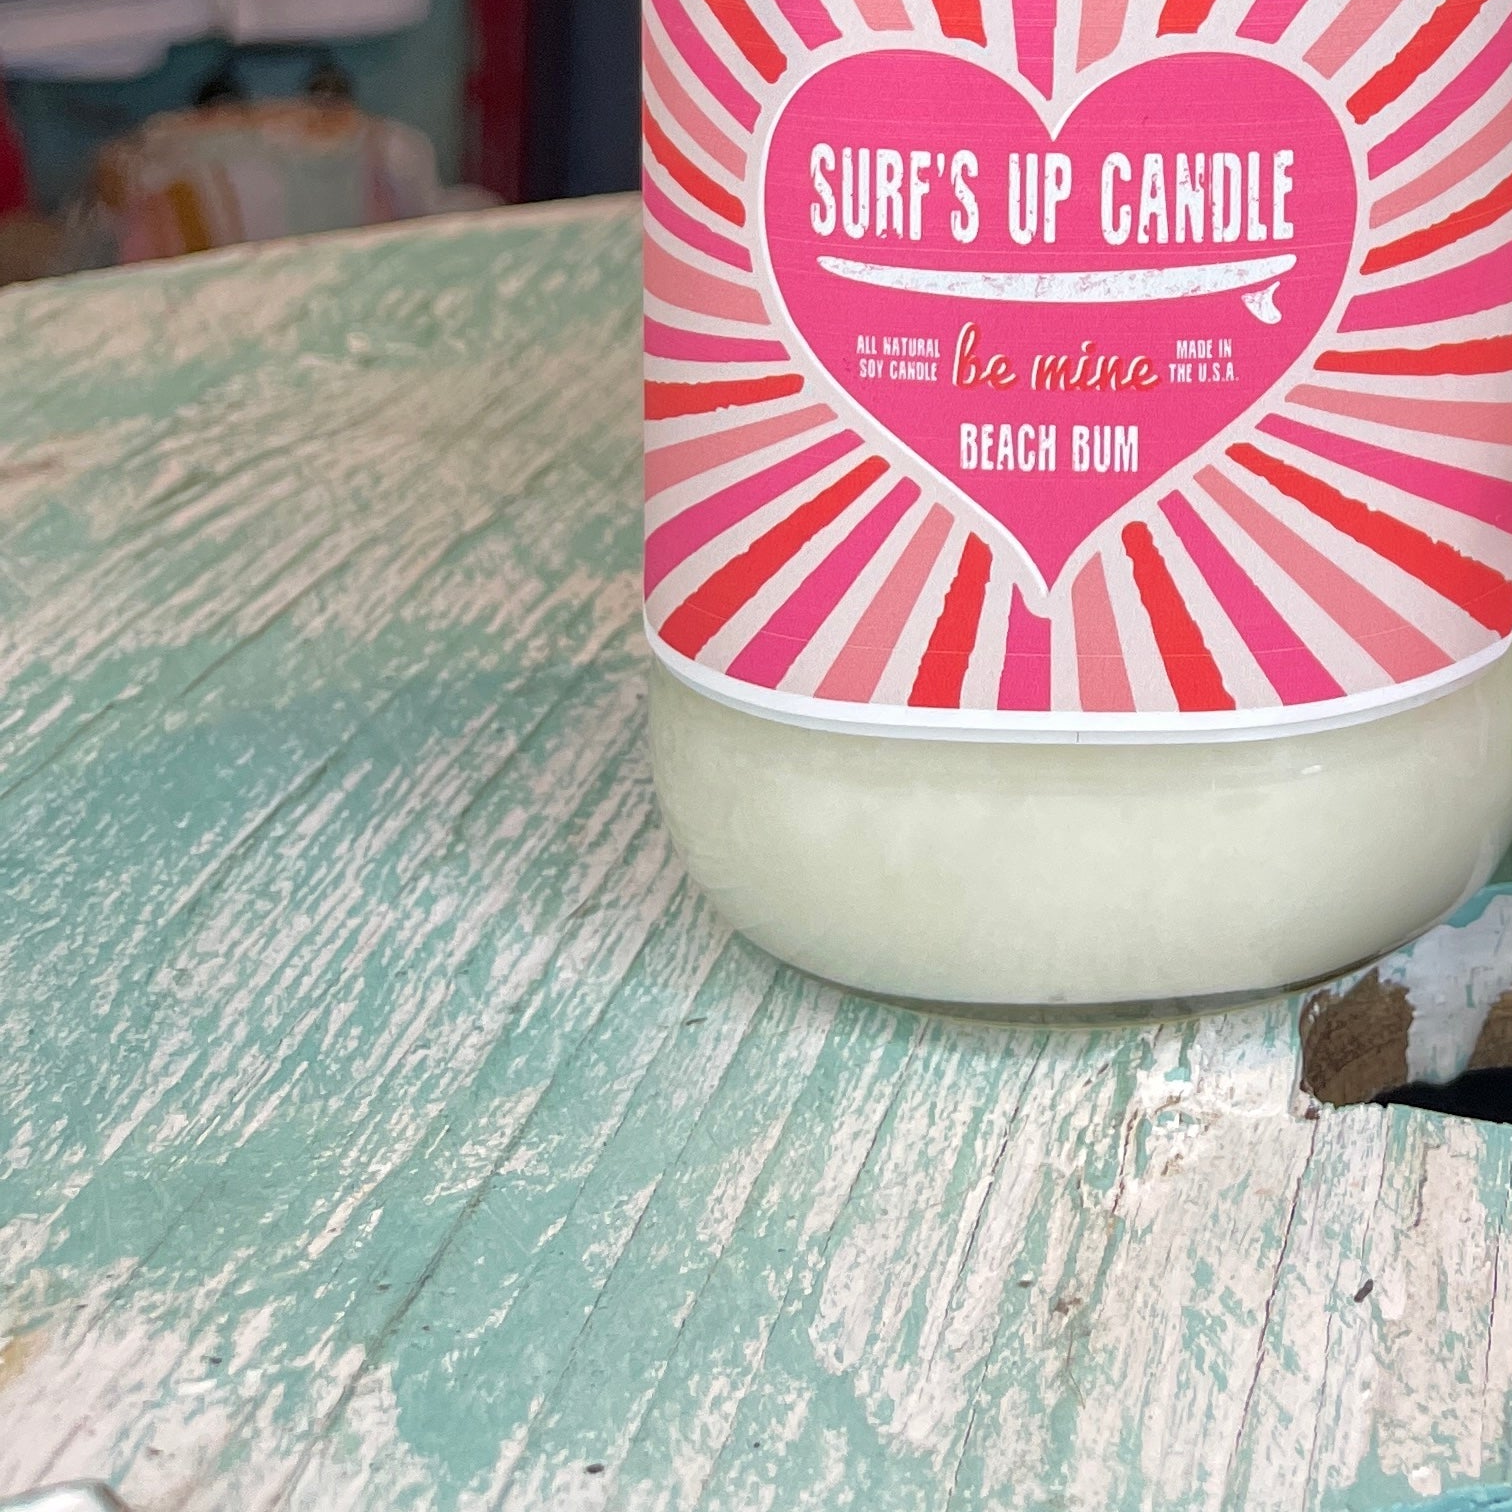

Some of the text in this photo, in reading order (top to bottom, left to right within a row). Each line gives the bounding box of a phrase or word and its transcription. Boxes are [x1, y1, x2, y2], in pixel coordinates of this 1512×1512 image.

[809, 142, 1296, 246] SURF'S UP CANDLE
[856, 334, 941, 359] ALL NATURAL
[952, 321, 1160, 392] be mine
[1176, 338, 1232, 360] MADE IN
[858, 357, 938, 382] SOY CANDLE
[1168, 362, 1193, 384] THE
[959, 422, 1139, 474] BEACH BUM
